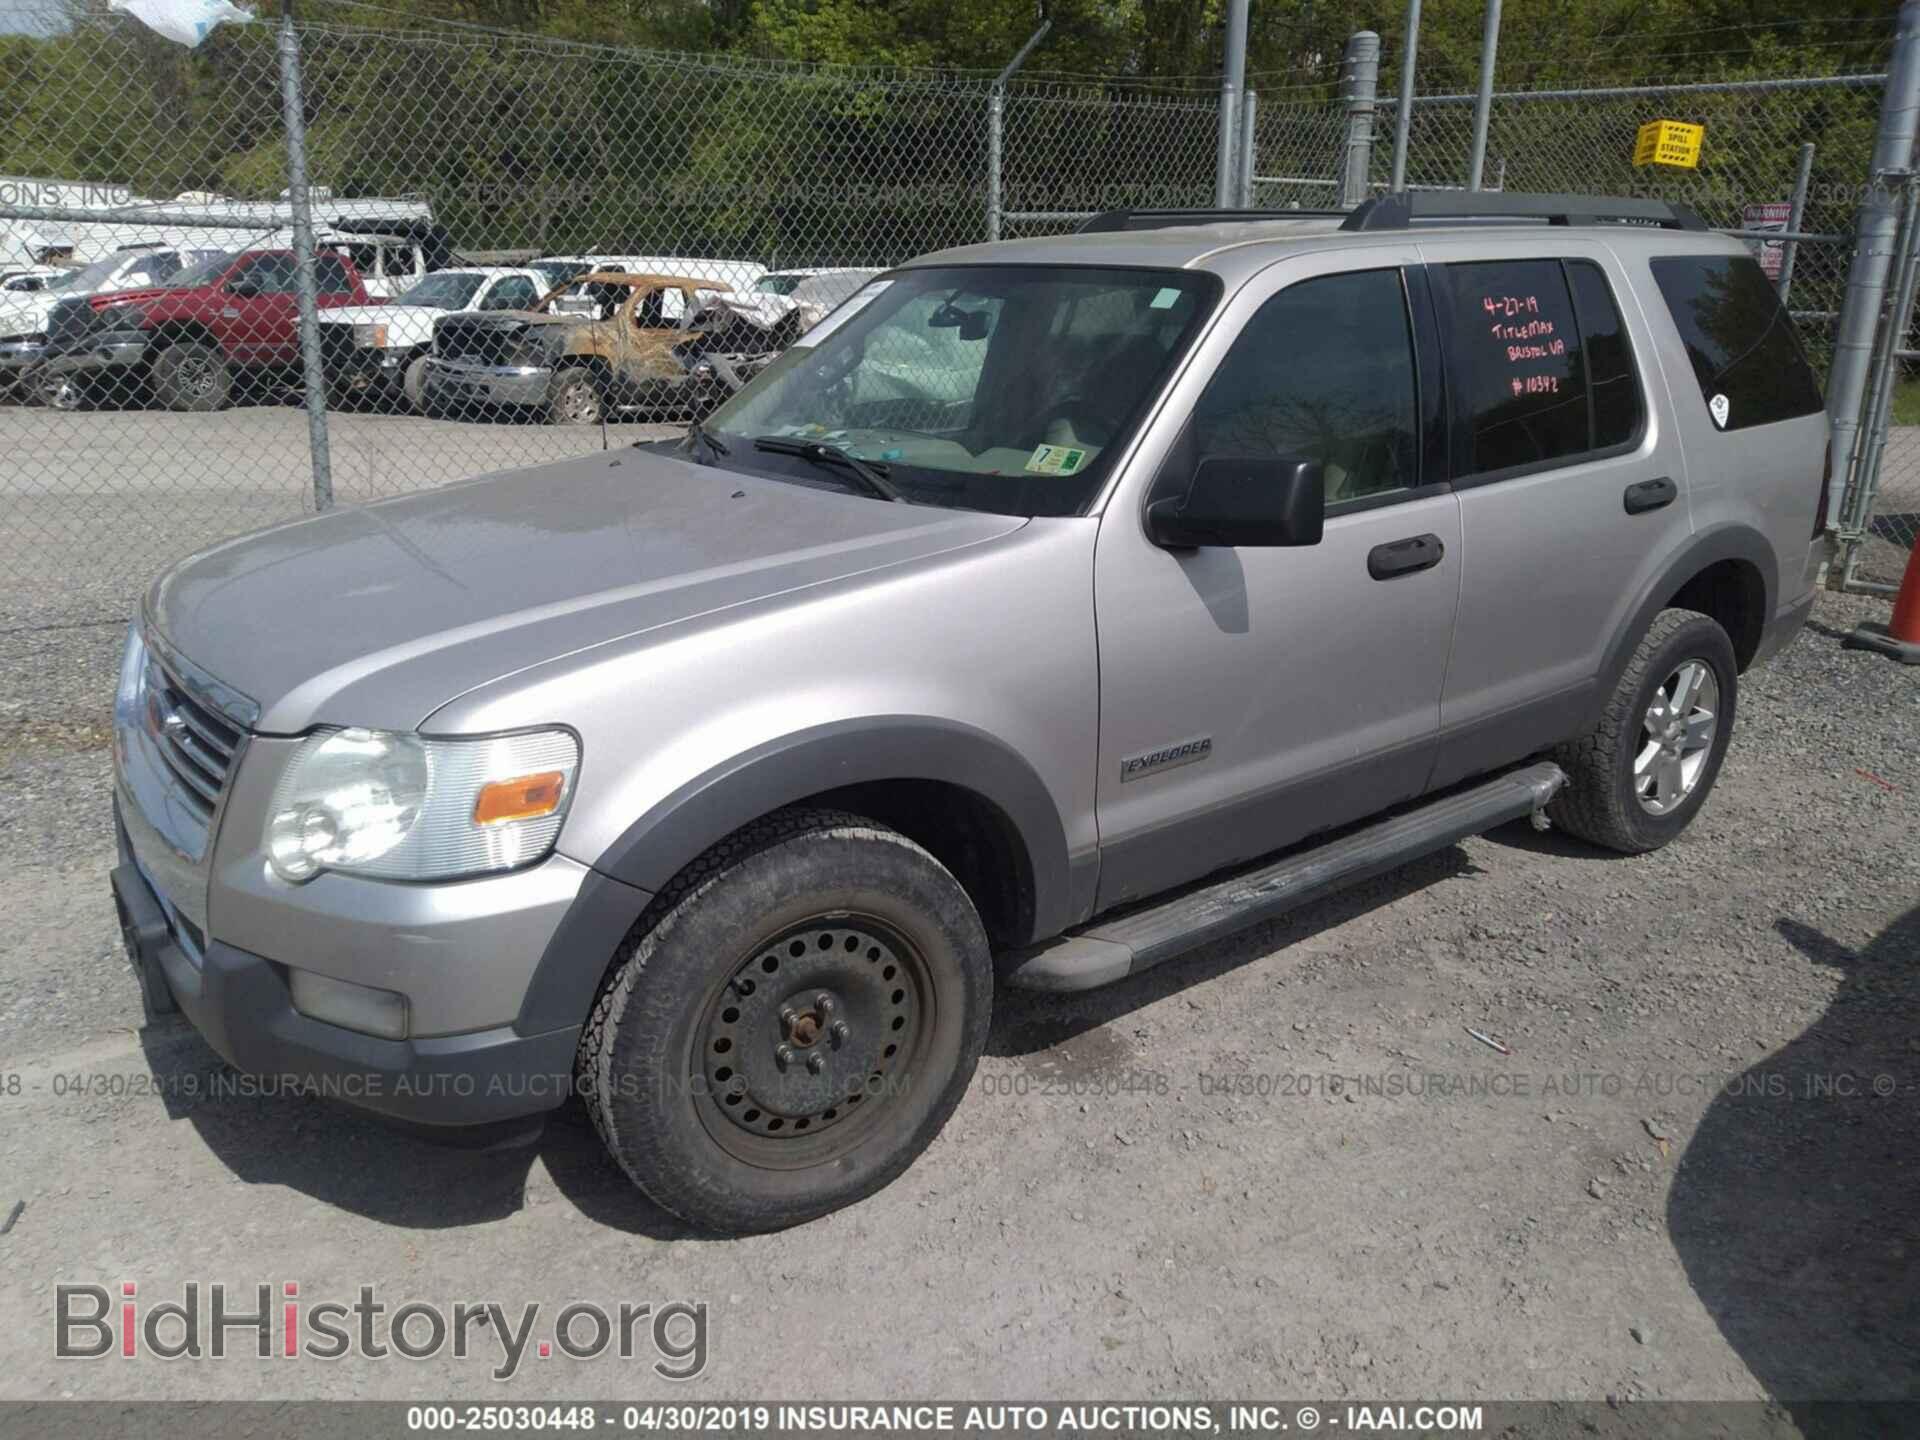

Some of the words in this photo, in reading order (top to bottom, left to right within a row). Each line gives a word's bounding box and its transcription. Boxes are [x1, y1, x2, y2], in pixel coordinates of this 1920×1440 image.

[1483, 296, 1539, 316] 4-27-19
[1507, 345, 1548, 361] BRISTOL
[1549, 338, 1565, 355] VA
[1526, 375, 1559, 393] 10342
[1127, 738, 1211, 773] EXPLORER
